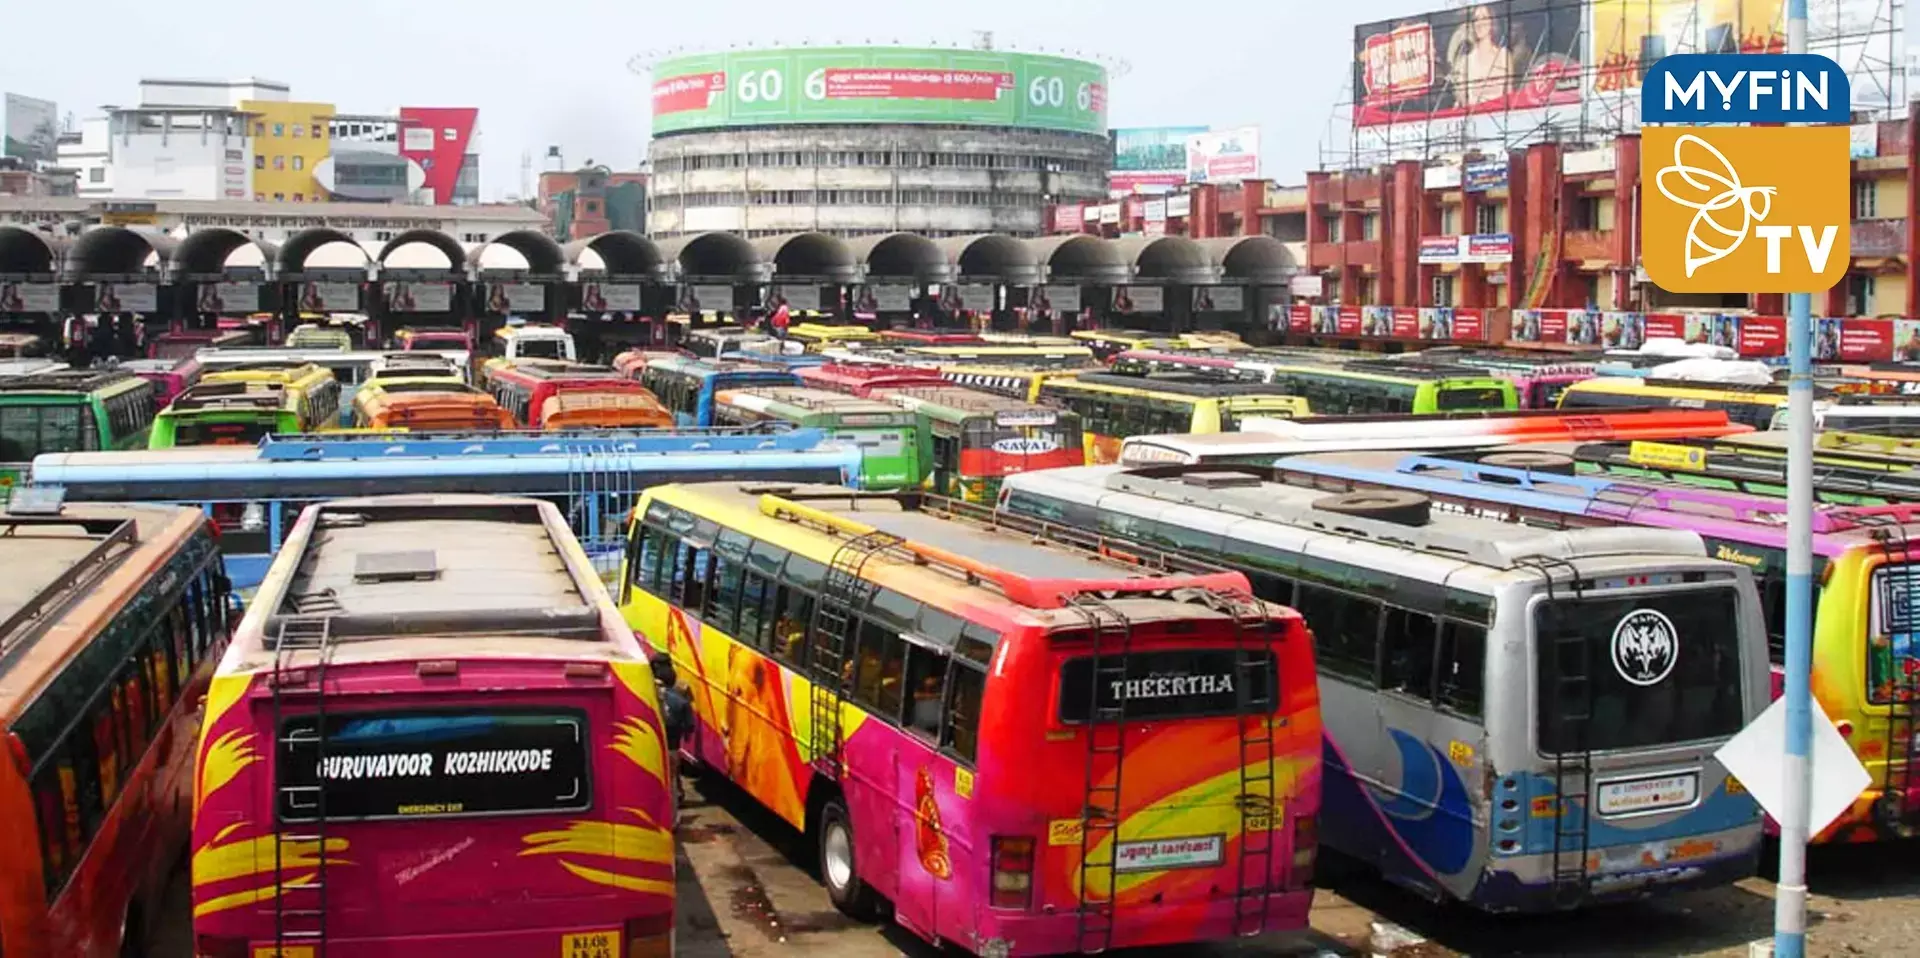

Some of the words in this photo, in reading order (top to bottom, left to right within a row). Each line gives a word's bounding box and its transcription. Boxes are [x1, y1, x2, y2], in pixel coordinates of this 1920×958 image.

[737, 68, 783, 103] 60
[1029, 75, 1064, 108] 60
[998, 441, 1052, 451] NAVAL
[1111, 674, 1234, 700] THEERTHA
[444, 749, 553, 776] KOZHIKKODE
[398, 804, 445, 814] EMERGENCY
